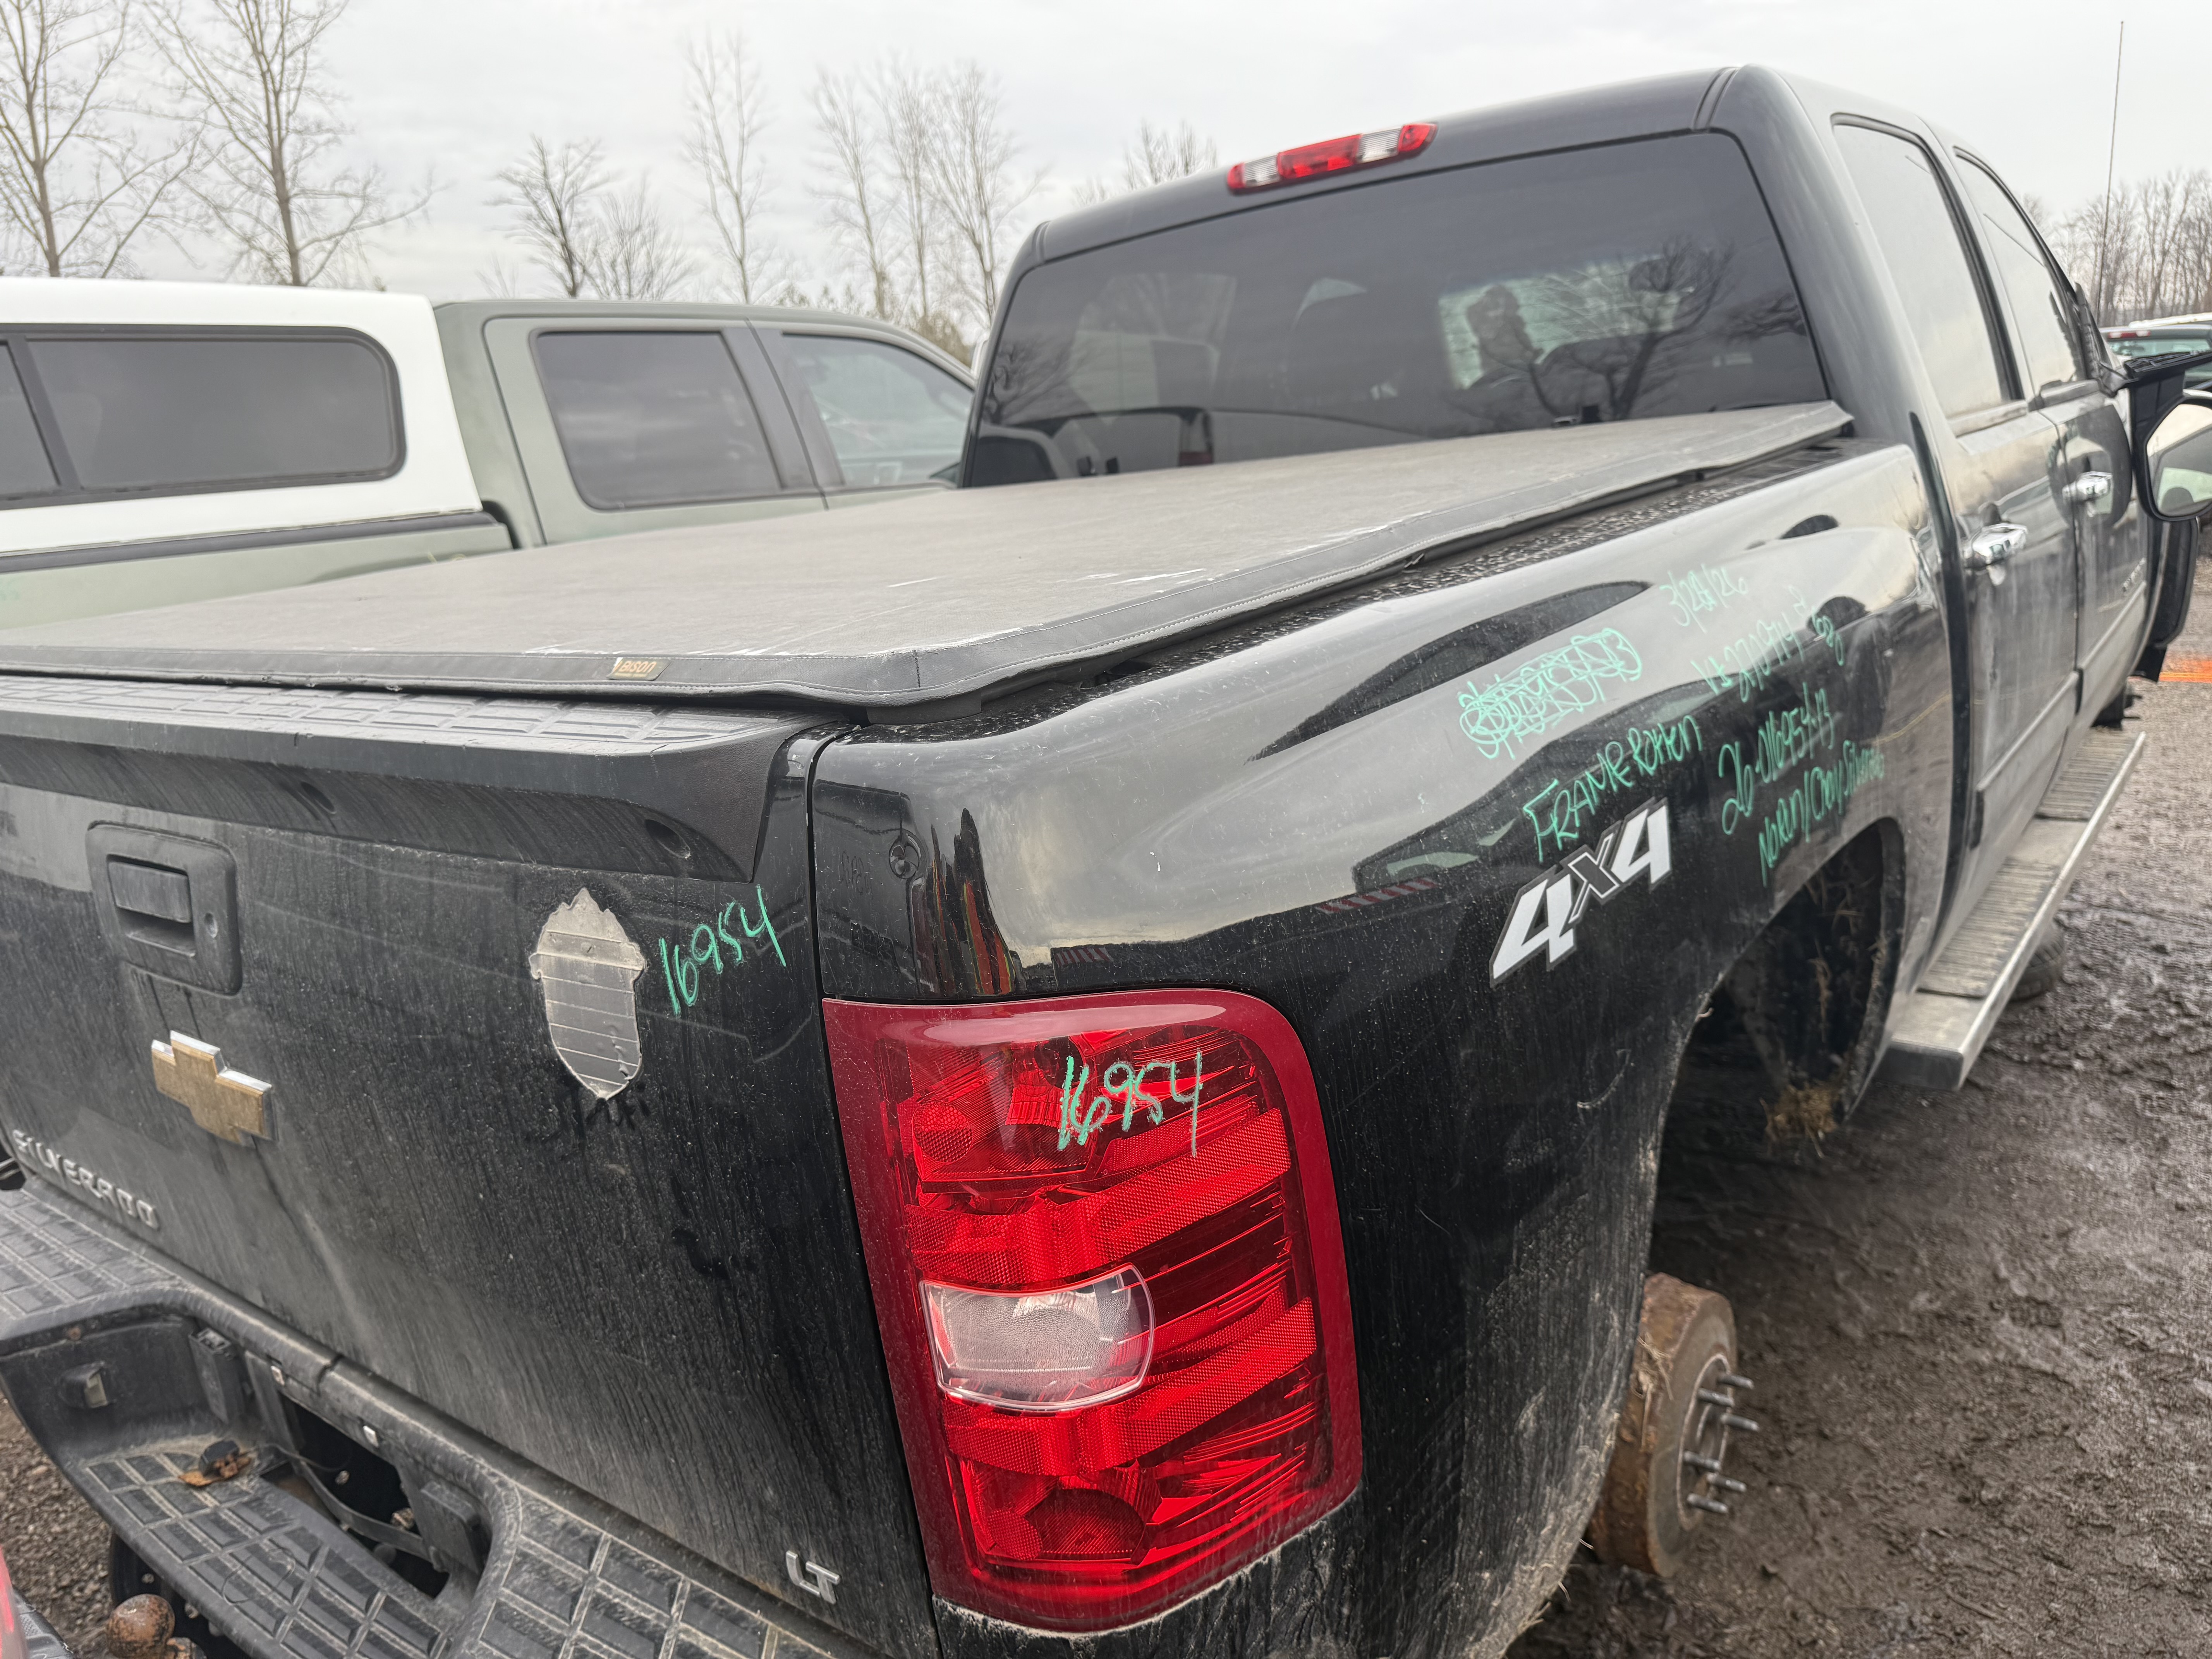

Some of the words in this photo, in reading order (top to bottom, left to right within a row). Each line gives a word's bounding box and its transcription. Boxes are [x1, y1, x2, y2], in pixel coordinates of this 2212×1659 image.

[618, 660, 657, 673] BISON
[1523, 740, 1634, 863] FRAME
[659, 884, 787, 1017] 16954
[1057, 1047, 1203, 1158] 16954
[13, 1129, 157, 1230] SILVERADO
[786, 1550, 841, 1605] LT
